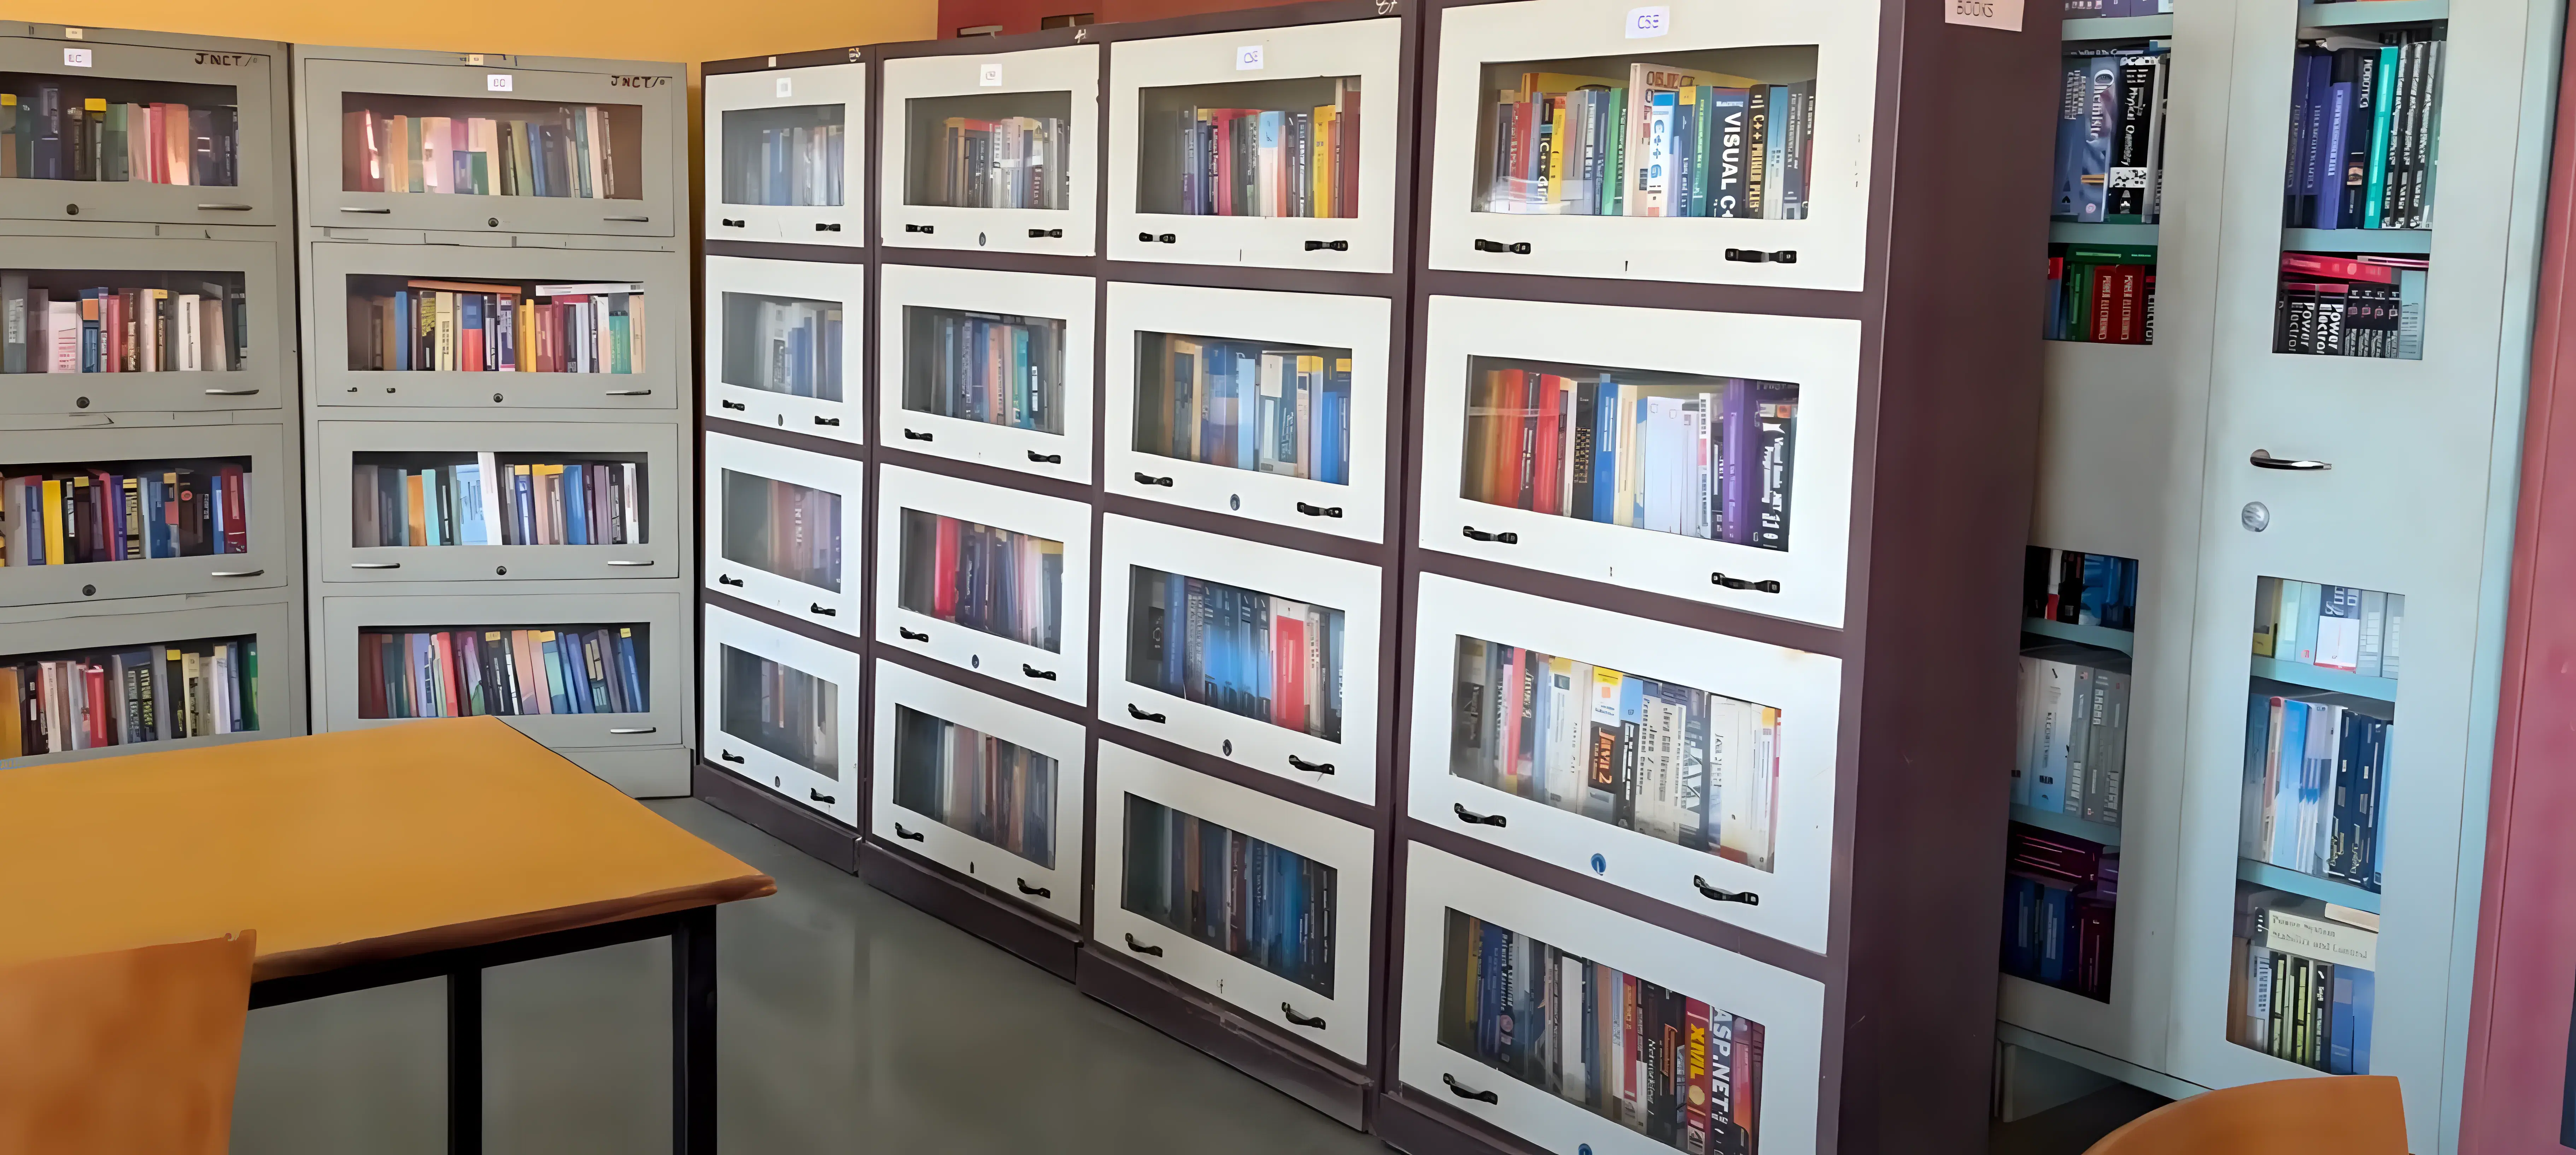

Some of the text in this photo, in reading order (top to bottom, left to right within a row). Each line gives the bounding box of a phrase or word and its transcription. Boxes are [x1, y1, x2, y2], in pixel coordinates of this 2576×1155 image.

[1638, 14, 1659, 29] CSE
[1753, 115, 1764, 140] C++
[1721, 112, 1742, 190] VISUAL
[1598, 772, 1612, 784] 2
[1690, 1023, 1705, 1079] XML
[1711, 1008, 1732, 1113] ASP.NET
